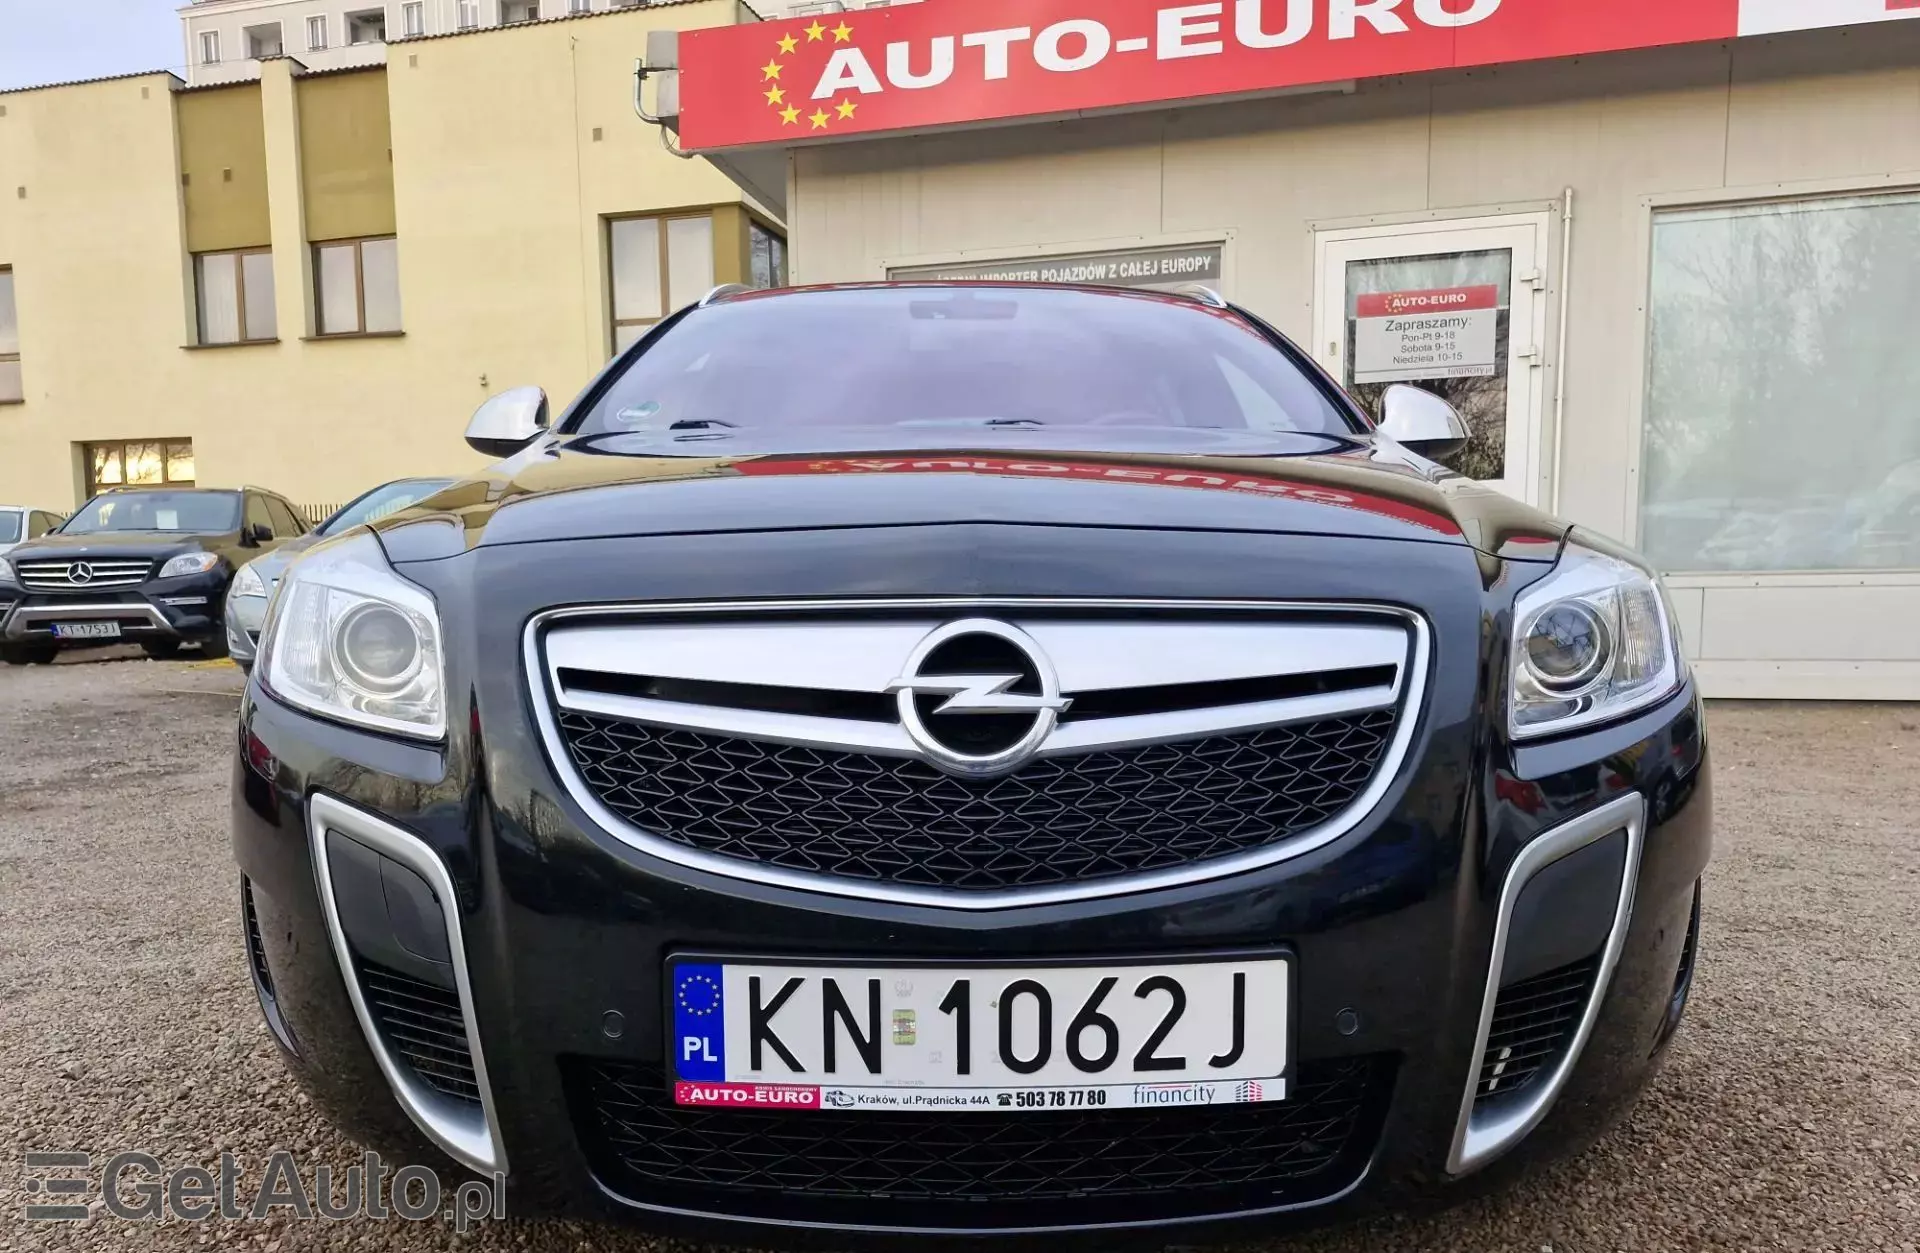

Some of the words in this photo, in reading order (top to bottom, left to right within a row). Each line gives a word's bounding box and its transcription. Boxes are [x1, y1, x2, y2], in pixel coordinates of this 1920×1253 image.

[810, 0, 1500, 101] AUTO-EURO
[1041, 263, 1106, 282] POJAZDÓW
[1108, 264, 1117, 279] Z
[1119, 260, 1158, 277] CAŁEJ
[1161, 256, 1212, 274] EUROPY
[1392, 293, 1467, 308] AUTO-EURO
[1385, 316, 1472, 333] Zapraszamy:
[1401, 332, 1432, 342] Pon-Pt
[1434, 331, 1455, 340] 9-18
[1400, 344, 1432, 353] Sobota
[1434, 342, 1456, 351] 9-15
[1392, 355, 1434, 364] Niedziela
[1437, 352, 1463, 361] 10-15
[747, 974, 883, 1075] KN
[938, 970, 1247, 1076] 1062J
[683, 1036, 718, 1062] PL
[690, 1088, 814, 1104] AUTO-EURO
[857, 1094, 900, 1106] Kraków,
[902, 1094, 968, 1107] ul.Prądnicka
[969, 1095, 991, 1105] 44A
[1016, 1091, 1045, 1107] 503
[1048, 1090, 1066, 1106] 78
[1069, 1090, 1084, 1106] 77
[1087, 1089, 1107, 1106] 80
[1133, 1084, 1216, 1105] financity
